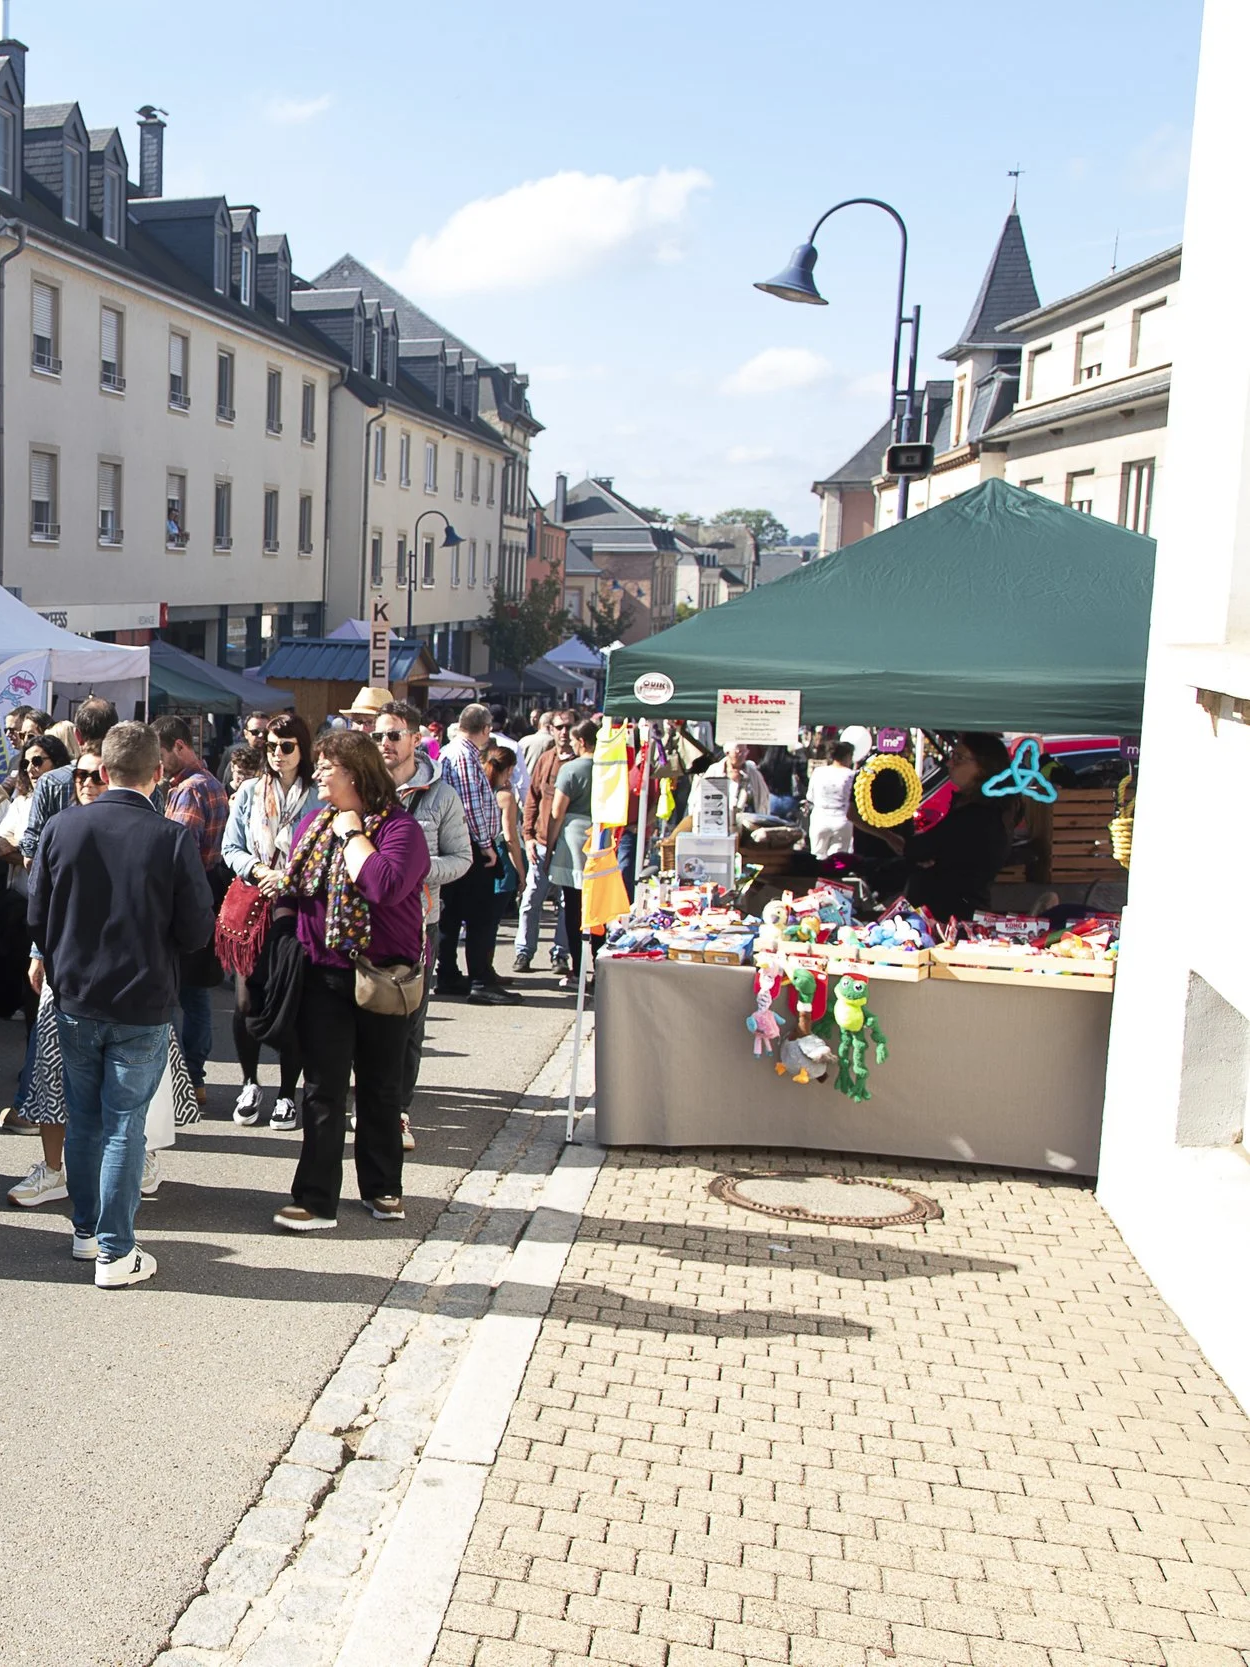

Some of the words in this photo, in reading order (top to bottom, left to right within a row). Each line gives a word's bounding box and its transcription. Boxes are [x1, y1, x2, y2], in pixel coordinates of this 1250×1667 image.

[722, 694, 747, 705] Pet's
[748, 695, 786, 706] Heaven
[1005, 922, 1023, 930] KONG
